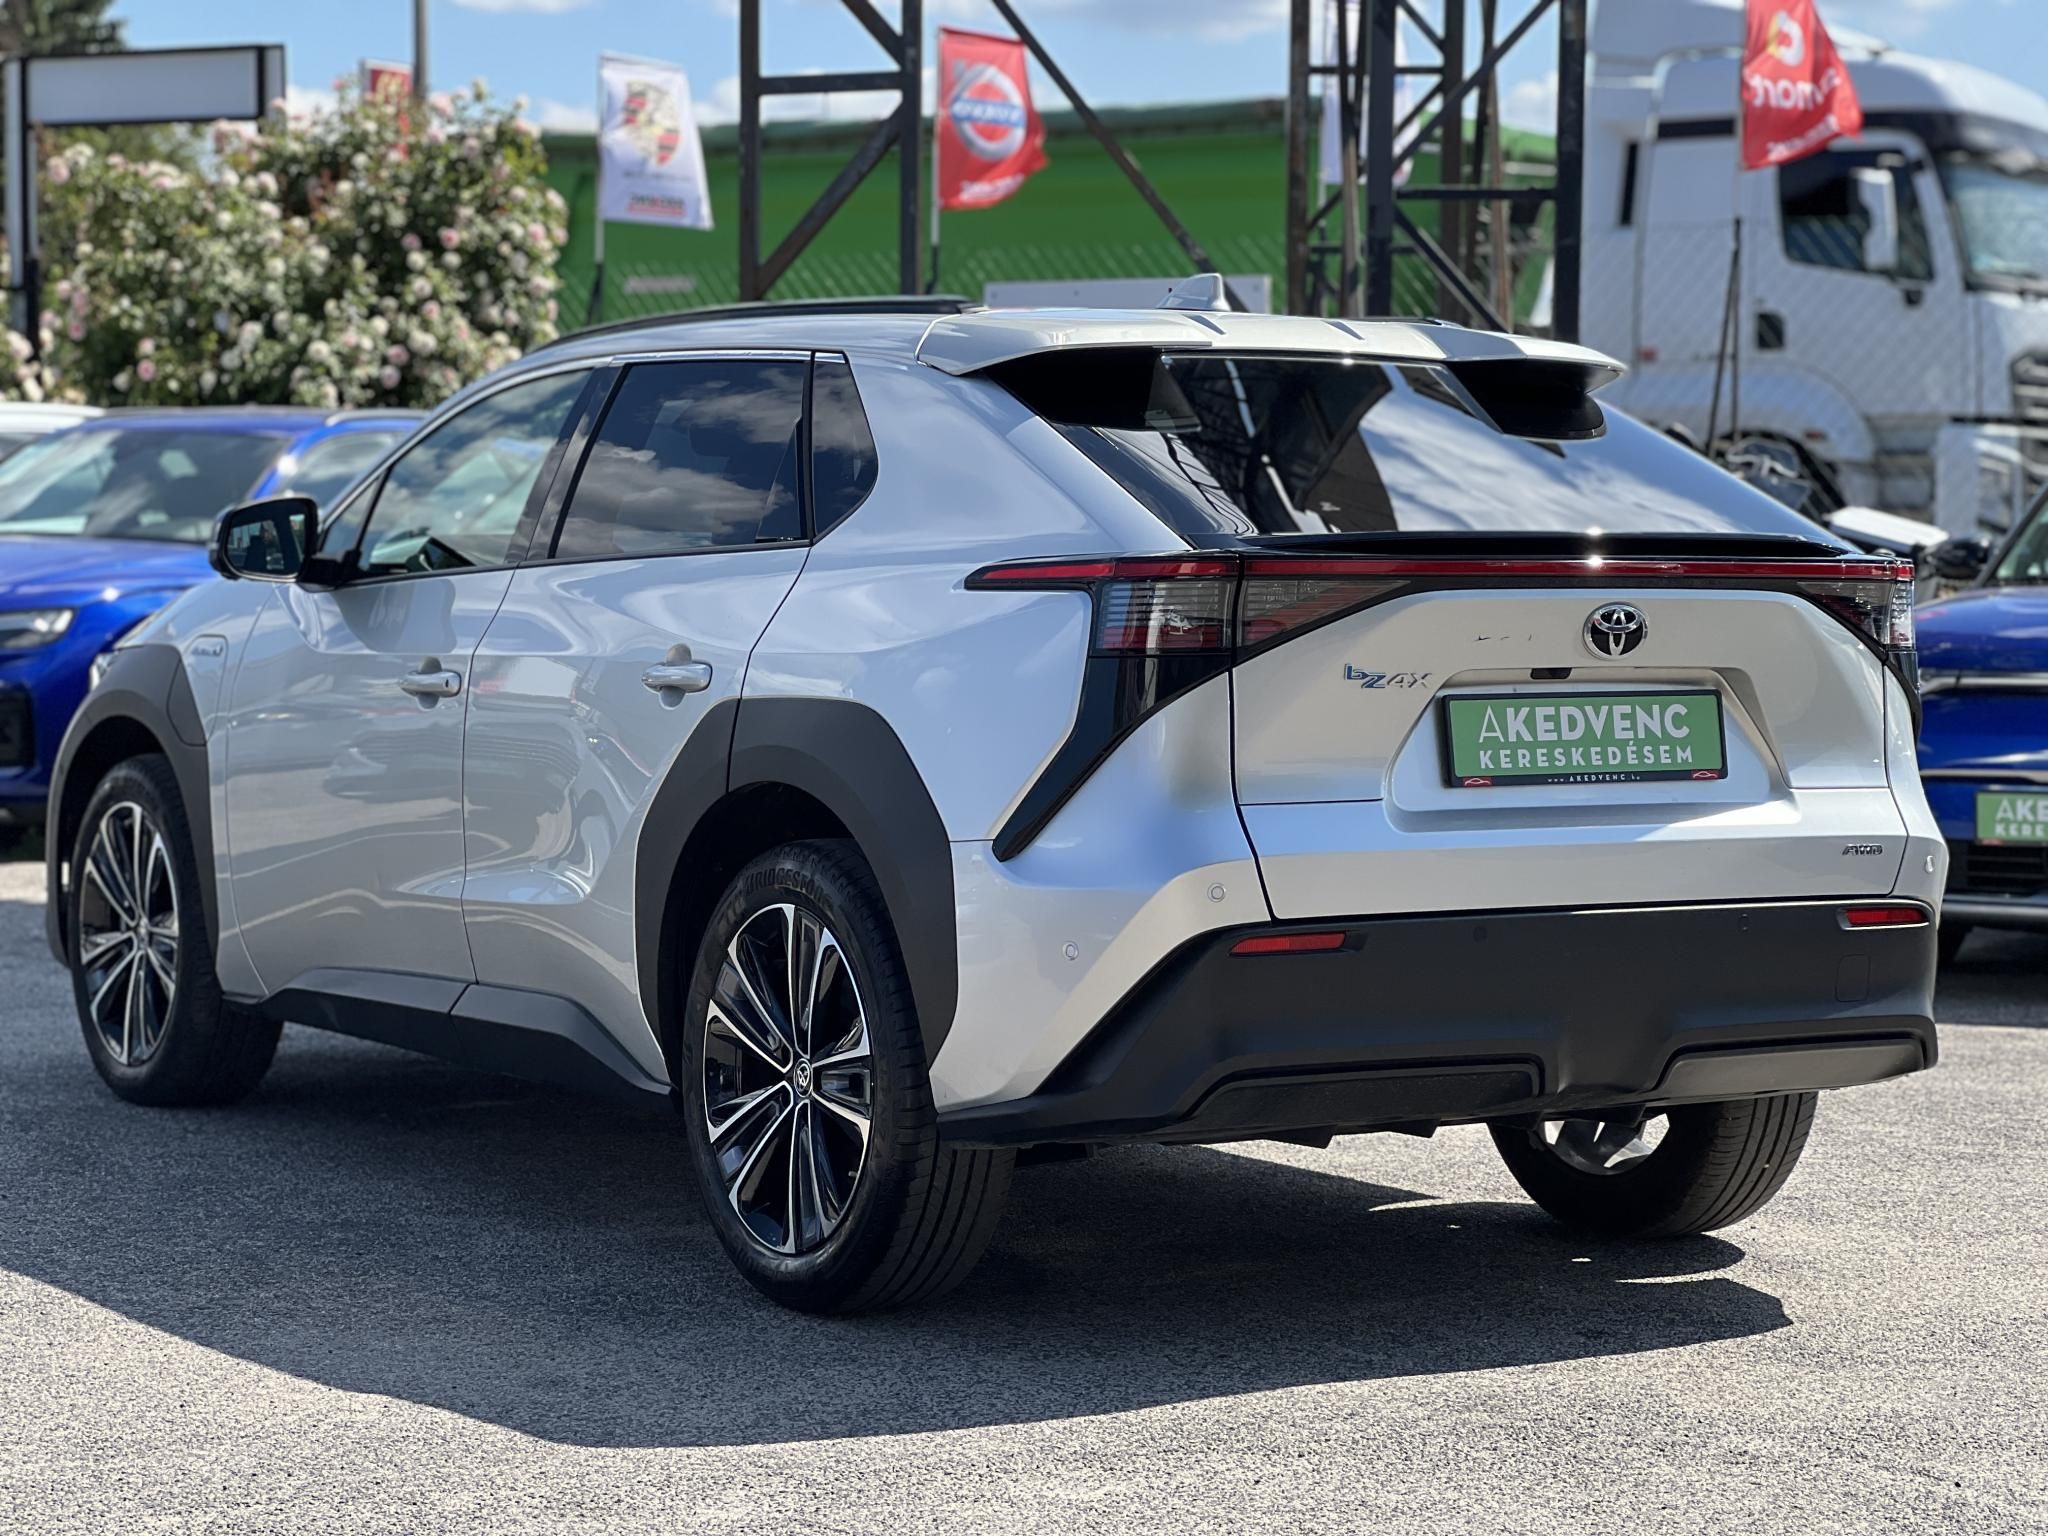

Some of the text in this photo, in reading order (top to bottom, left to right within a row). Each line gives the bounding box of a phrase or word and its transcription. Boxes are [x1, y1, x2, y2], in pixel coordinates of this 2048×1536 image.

[1479, 704, 1690, 743] AKEDVENC
[1479, 741, 1693, 769] KERESKEDÉSEM
[1842, 843, 1883, 855] AWD
